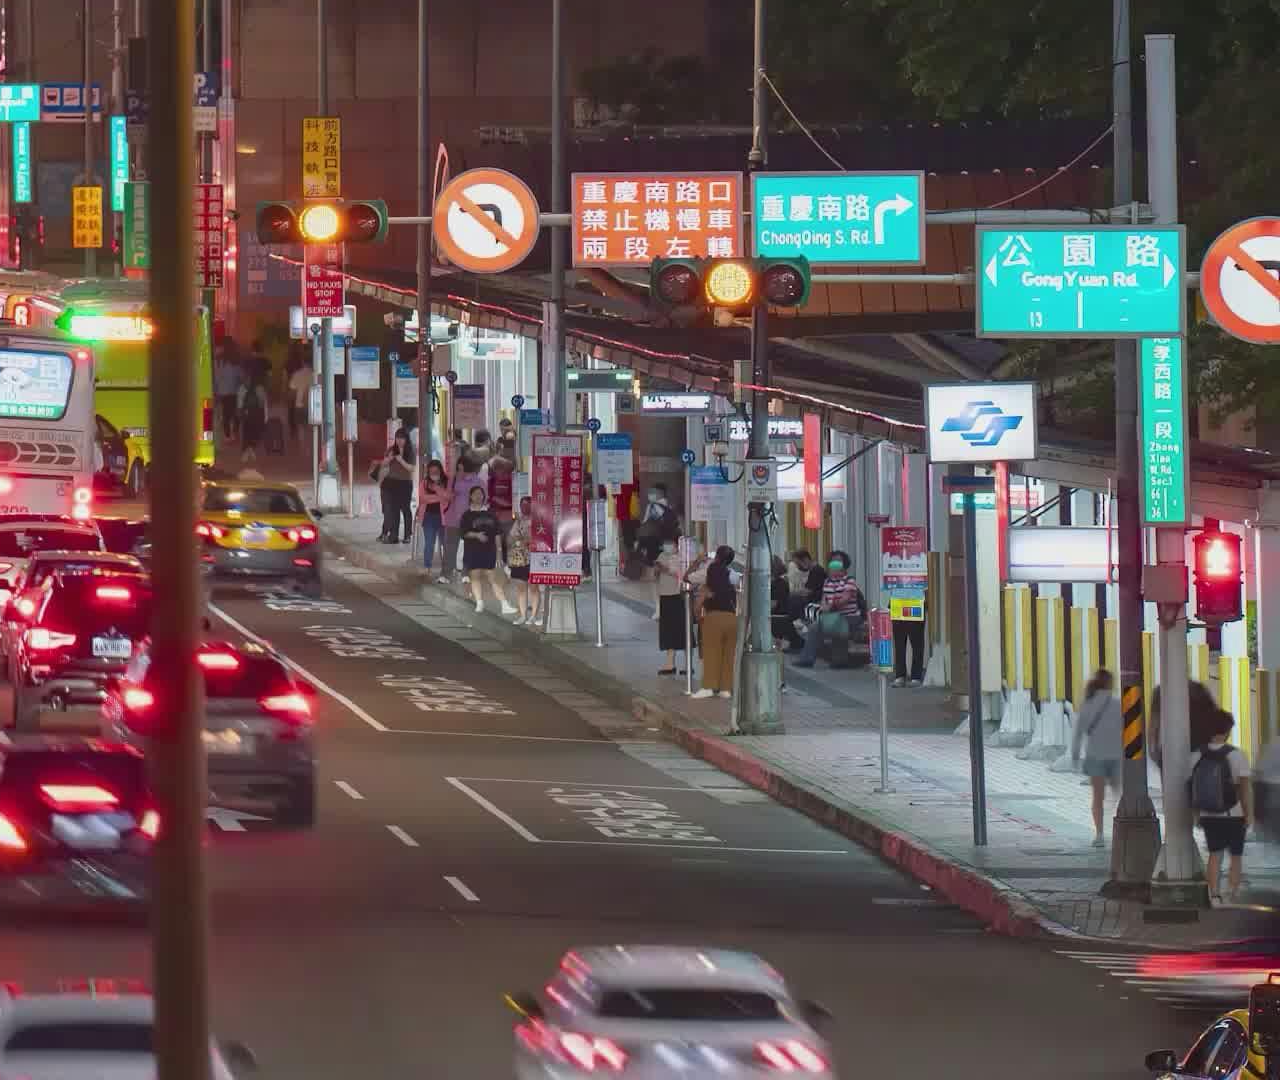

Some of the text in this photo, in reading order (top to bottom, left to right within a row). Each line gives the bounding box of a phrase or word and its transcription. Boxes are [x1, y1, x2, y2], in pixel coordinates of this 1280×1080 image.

[581, 181, 731, 203] 重慶南路口
[761, 195, 871, 222] 重慶南路
[581, 208, 733, 232] 禁止機慢車
[582, 237, 734, 259] 兩段左轉
[761, 230, 831, 247] ChongQing
[999, 235, 1160, 267] 公園路
[1030, 312, 1043, 327] 13
[682, 452, 694, 463] C1
